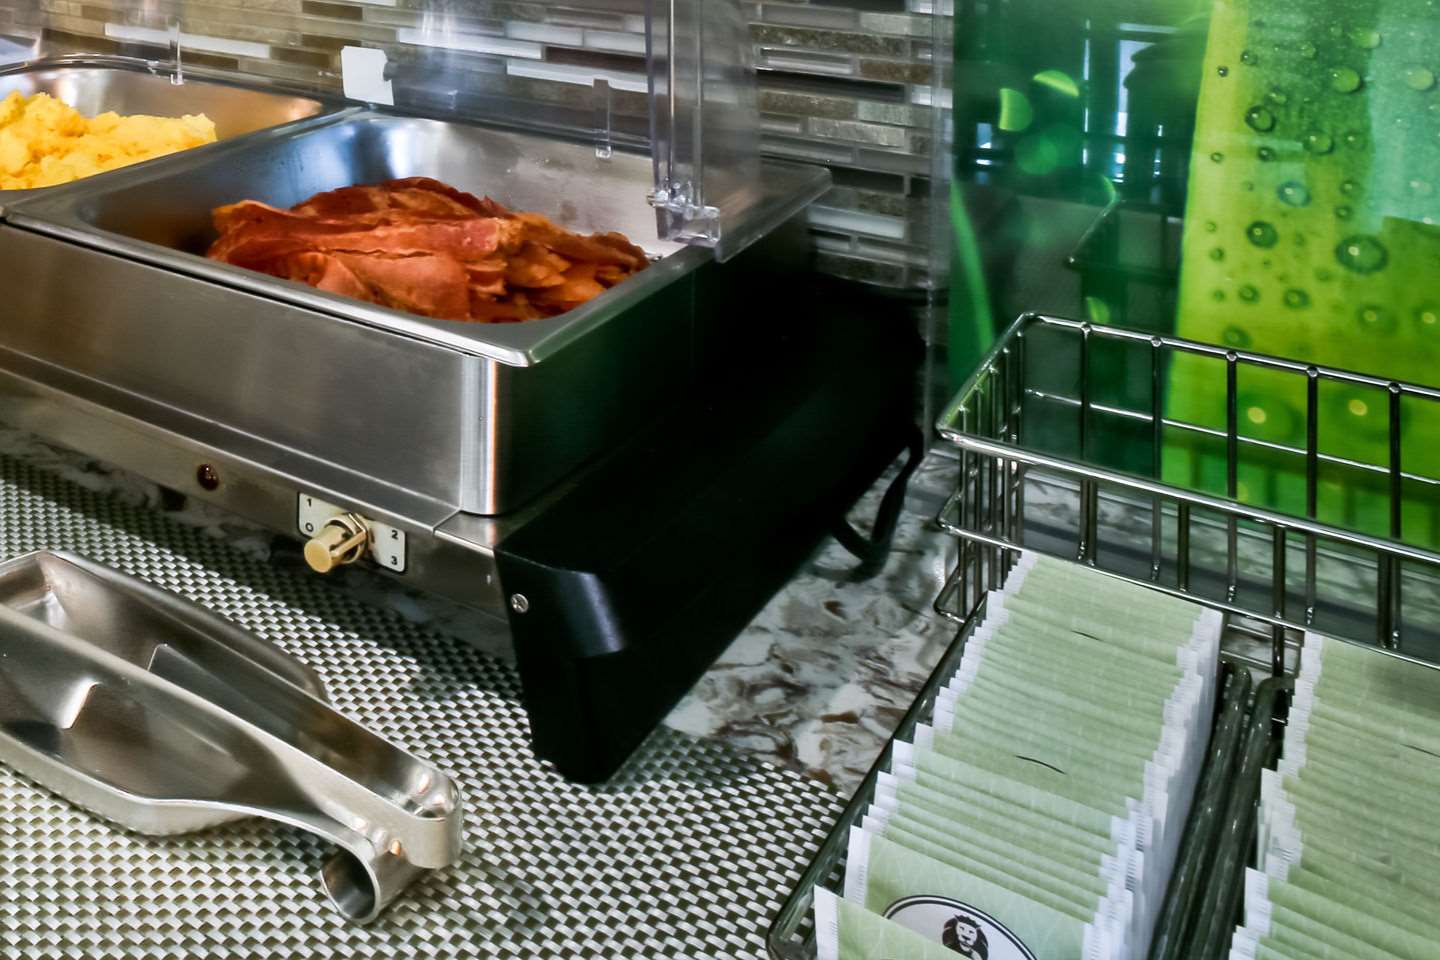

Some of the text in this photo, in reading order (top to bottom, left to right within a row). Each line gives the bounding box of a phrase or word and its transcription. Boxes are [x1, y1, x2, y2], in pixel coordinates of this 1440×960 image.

[306, 498, 313, 507] 1
[391, 529, 399, 540] 2
[390, 555, 398, 566] 3
